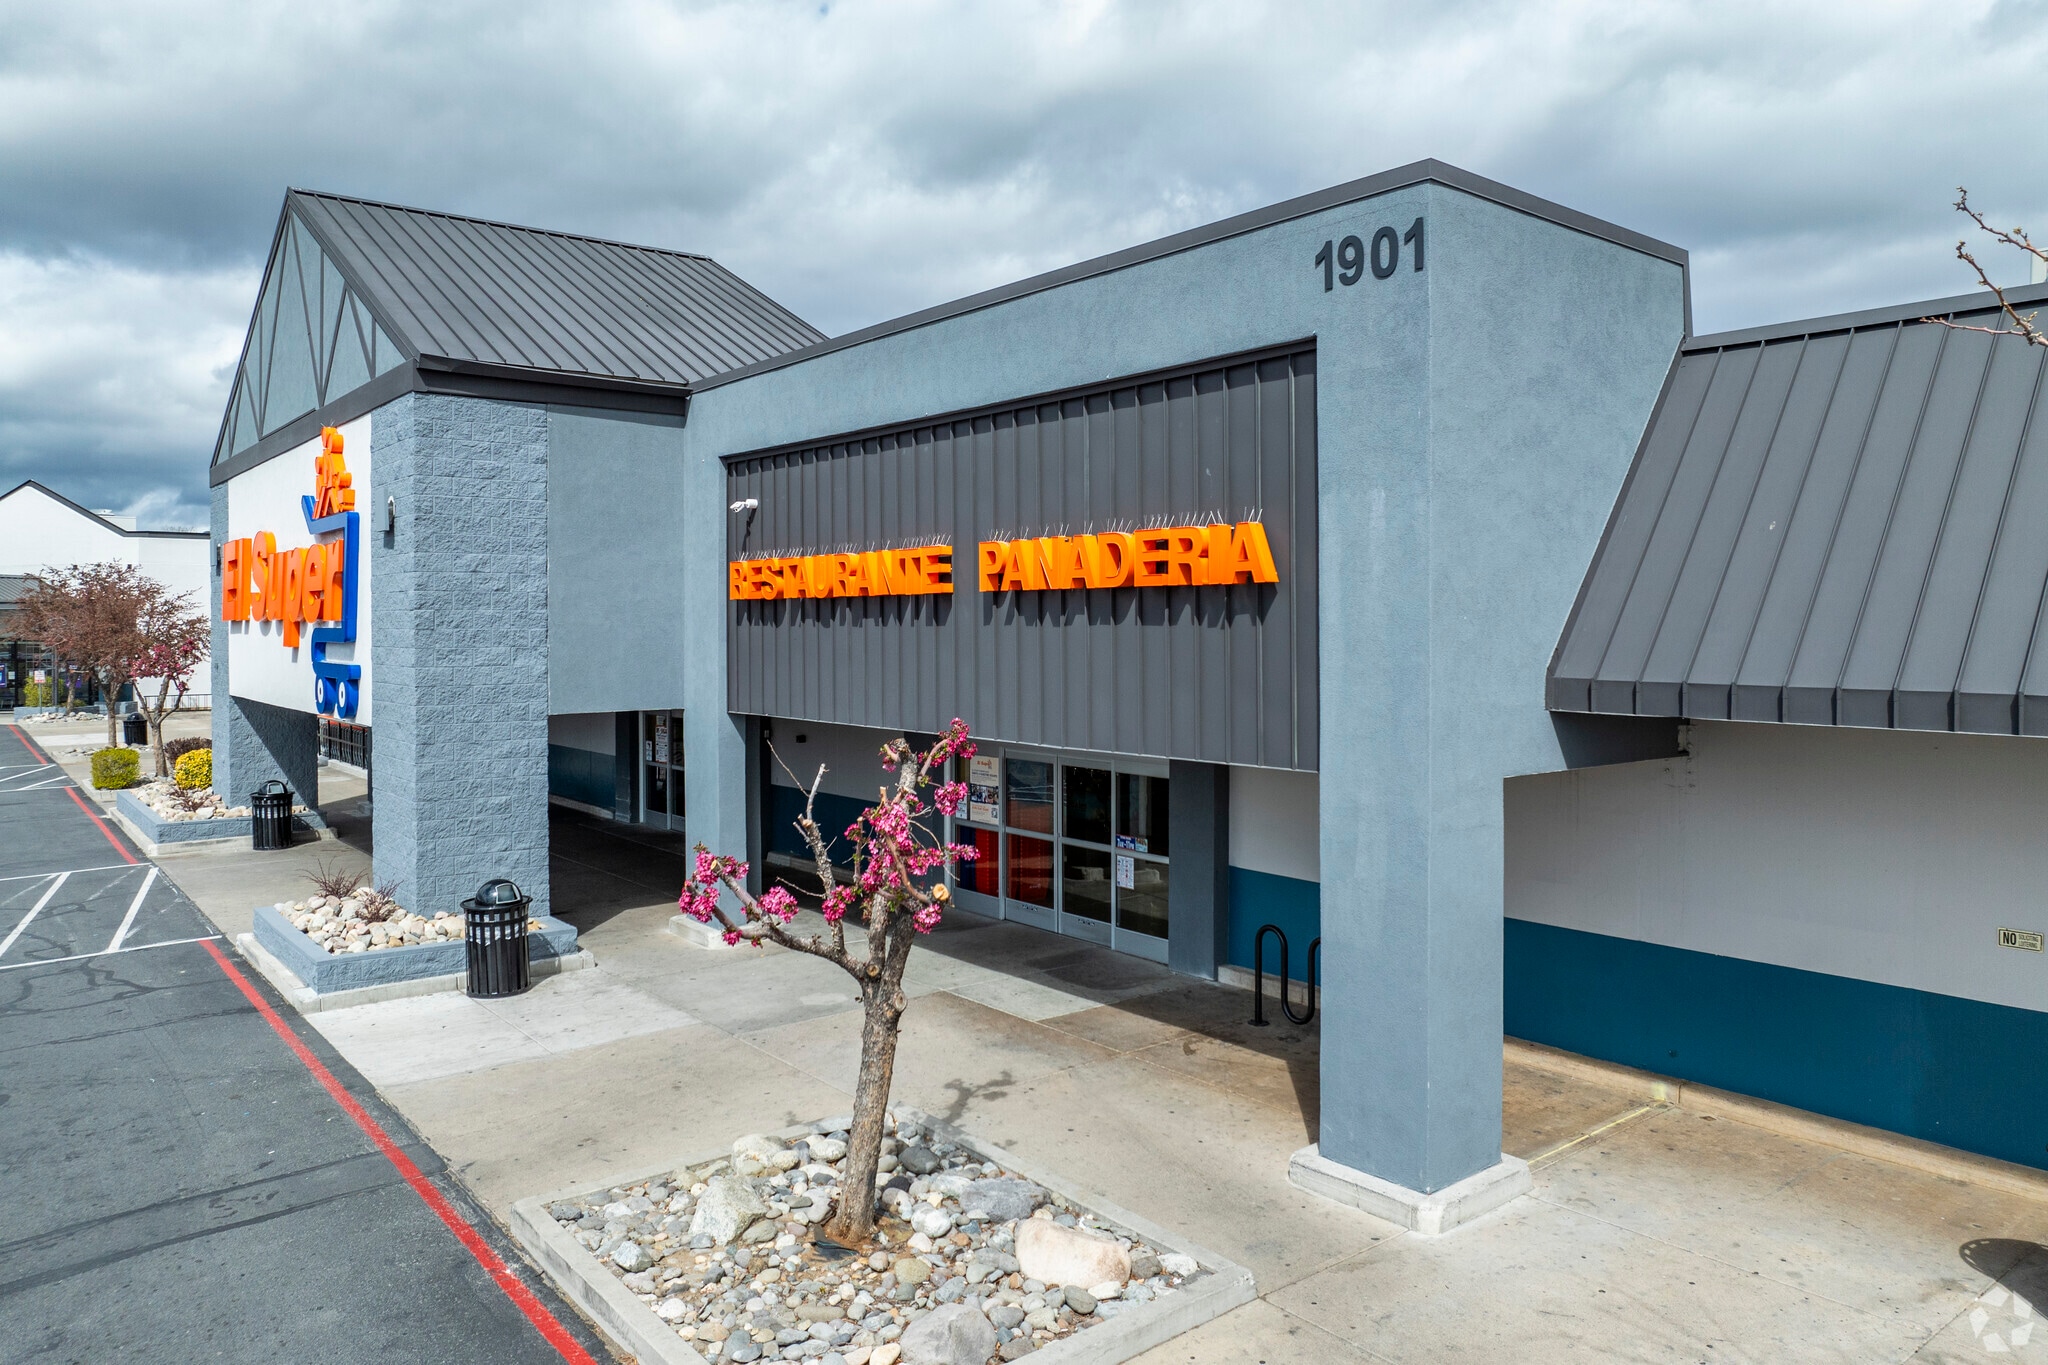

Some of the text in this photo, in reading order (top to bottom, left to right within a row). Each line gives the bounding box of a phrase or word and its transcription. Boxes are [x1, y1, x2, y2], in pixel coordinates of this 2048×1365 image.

[1315, 216, 1424, 293] 1901
[222, 530, 344, 648] El Super
[729, 521, 1279, 601] RESTAURANTE PANADERIA
[2003, 931, 2017, 946] NO
